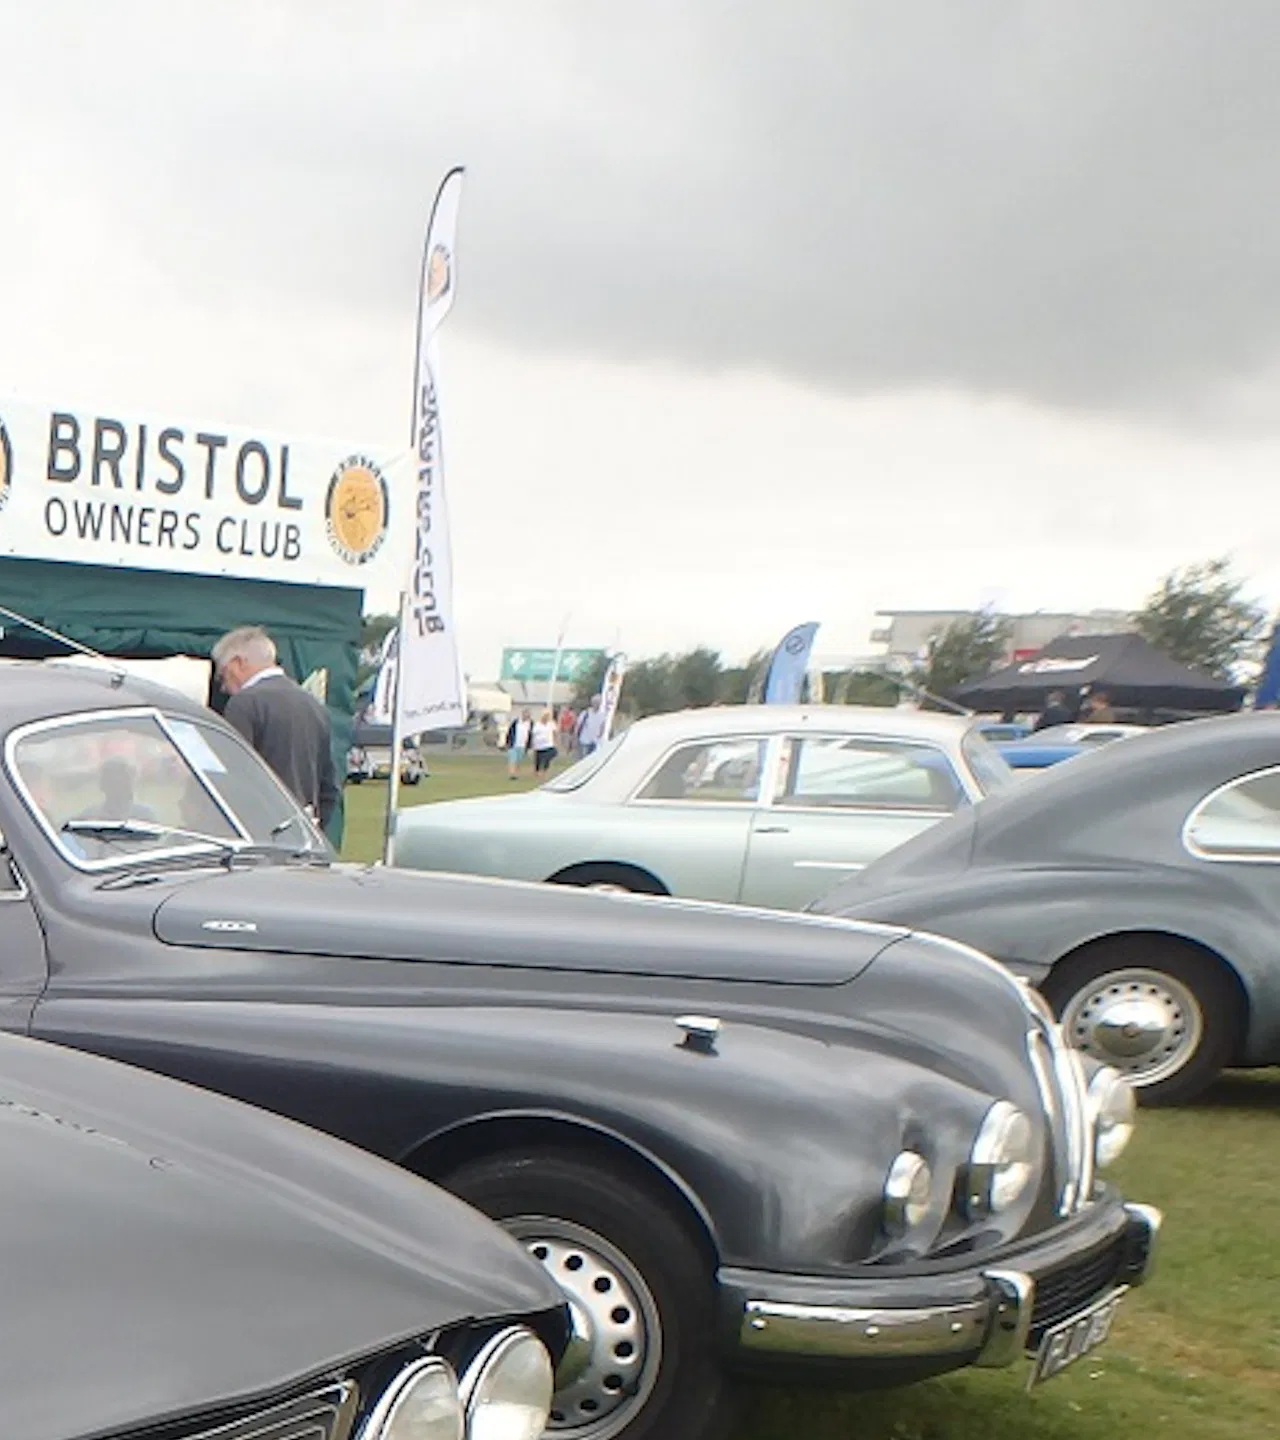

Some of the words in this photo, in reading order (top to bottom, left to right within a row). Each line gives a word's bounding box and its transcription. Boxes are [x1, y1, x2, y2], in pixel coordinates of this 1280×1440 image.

[47, 412, 303, 510] BRISTOL
[45, 497, 200, 550] OWNERS
[216, 517, 301, 560] CLUB
